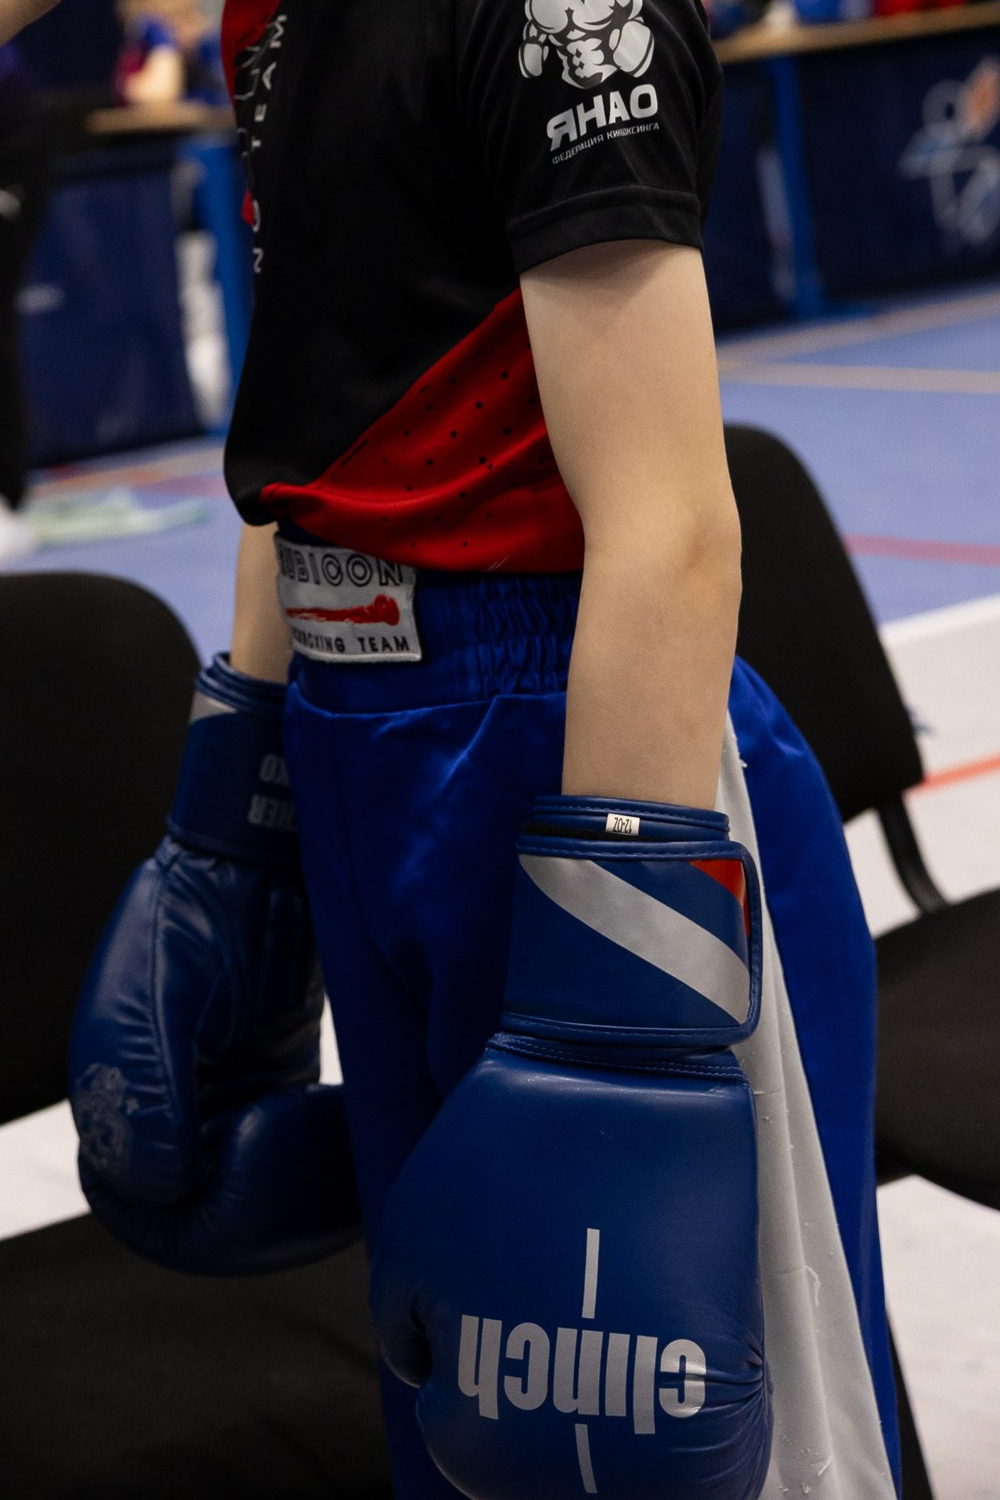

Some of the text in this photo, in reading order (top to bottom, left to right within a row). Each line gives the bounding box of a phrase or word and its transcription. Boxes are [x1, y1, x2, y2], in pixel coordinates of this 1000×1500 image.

[546, 83, 659, 152] ЯНАО
[551, 134, 604, 165] ФЕДЕРАЦИЯ
[357, 635, 410, 653] TEAM
